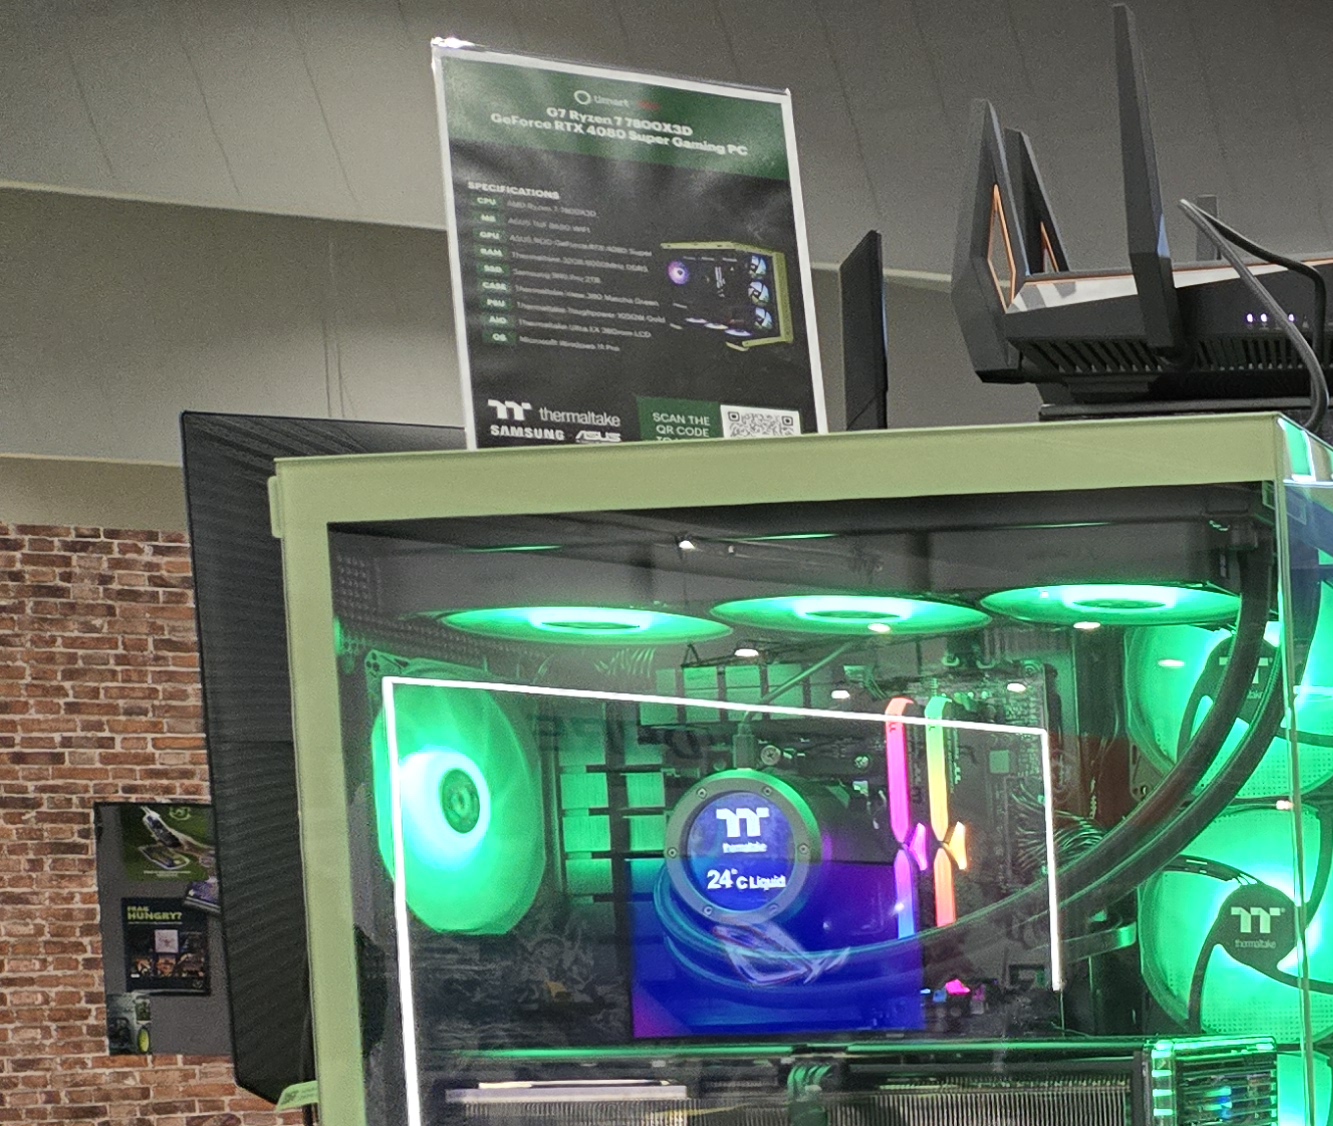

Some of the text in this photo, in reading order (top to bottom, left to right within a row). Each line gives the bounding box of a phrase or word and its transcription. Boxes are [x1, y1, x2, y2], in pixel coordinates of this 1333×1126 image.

[569, 110, 613, 126] Ryzen
[490, 112, 749, 156] GeForce RTX 4080 Super Gaming PC
[467, 181, 560, 200] SPECIFICATIONS
[538, 405, 621, 427] thermaltake
[652, 411, 711, 426] SCAN THE
[490, 424, 622, 443] SAMSUNG ASUS
[655, 424, 709, 438] QR CODE
[749, 874, 787, 891] Liquid
[127, 911, 183, 921] HUNGRY?
